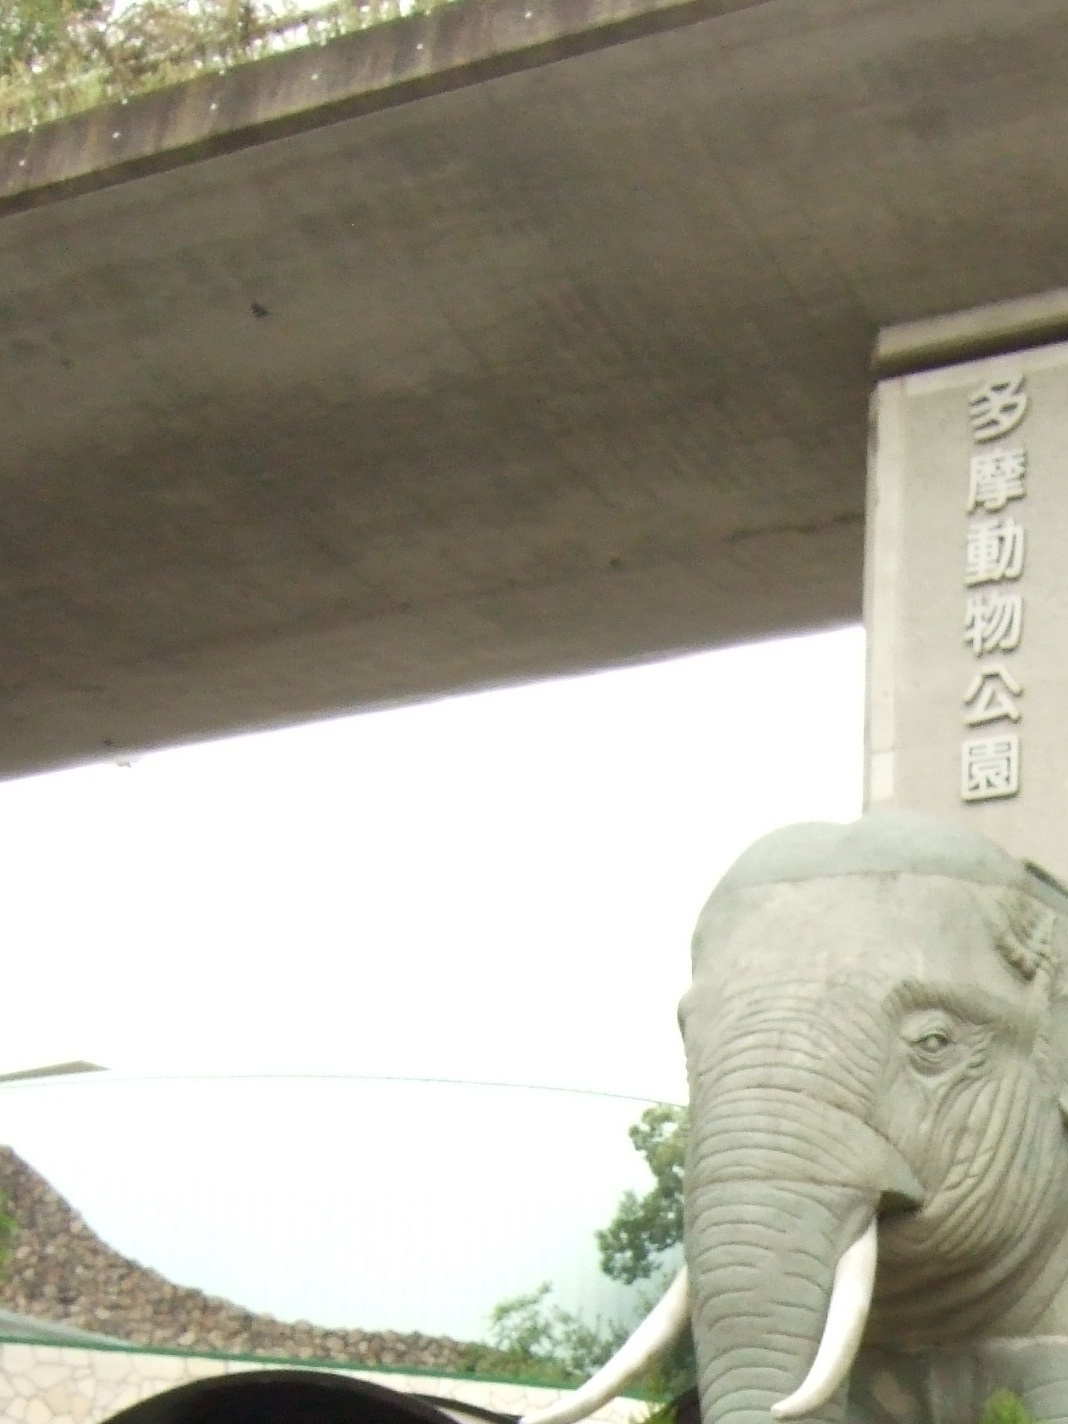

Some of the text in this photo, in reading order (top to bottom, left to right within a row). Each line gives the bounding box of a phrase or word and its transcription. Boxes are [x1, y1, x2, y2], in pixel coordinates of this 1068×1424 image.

[961, 369, 1028, 802] 多摩動物公園
